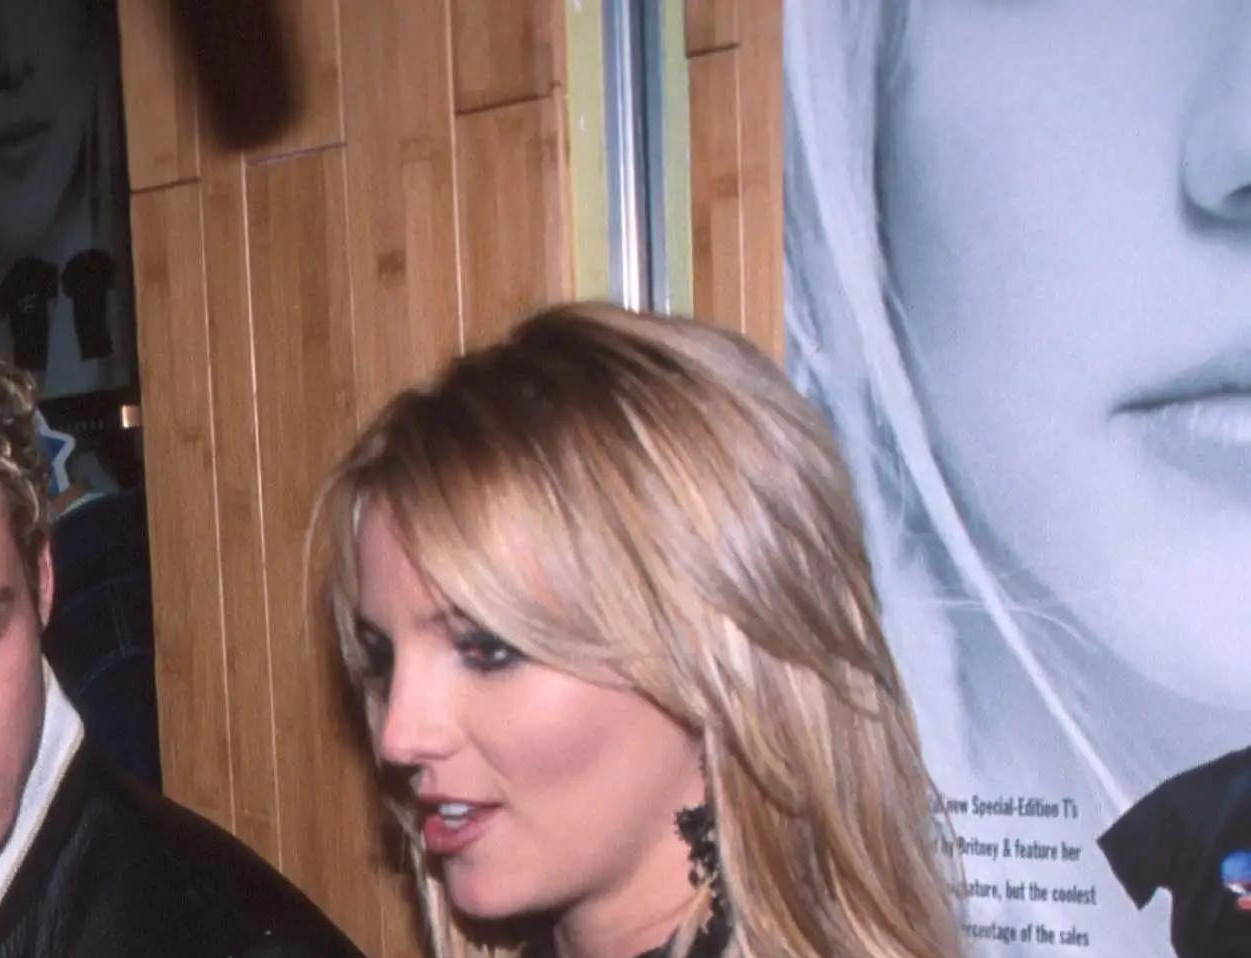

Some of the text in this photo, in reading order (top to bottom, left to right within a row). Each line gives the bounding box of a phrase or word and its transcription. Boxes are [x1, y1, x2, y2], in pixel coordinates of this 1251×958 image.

[971, 795, 1059, 818] Special-Edition
[1062, 798, 1079, 819] T's
[1003, 838, 1011, 858] &
[1014, 838, 1058, 860] feature
[1061, 841, 1081, 862] her
[1006, 881, 1025, 900] but
[1029, 882, 1048, 901] the
[1052, 885, 1097, 905] coolest
[1020, 923, 1032, 942] of
[1035, 924, 1055, 944] the
[1059, 925, 1090, 947] sales
